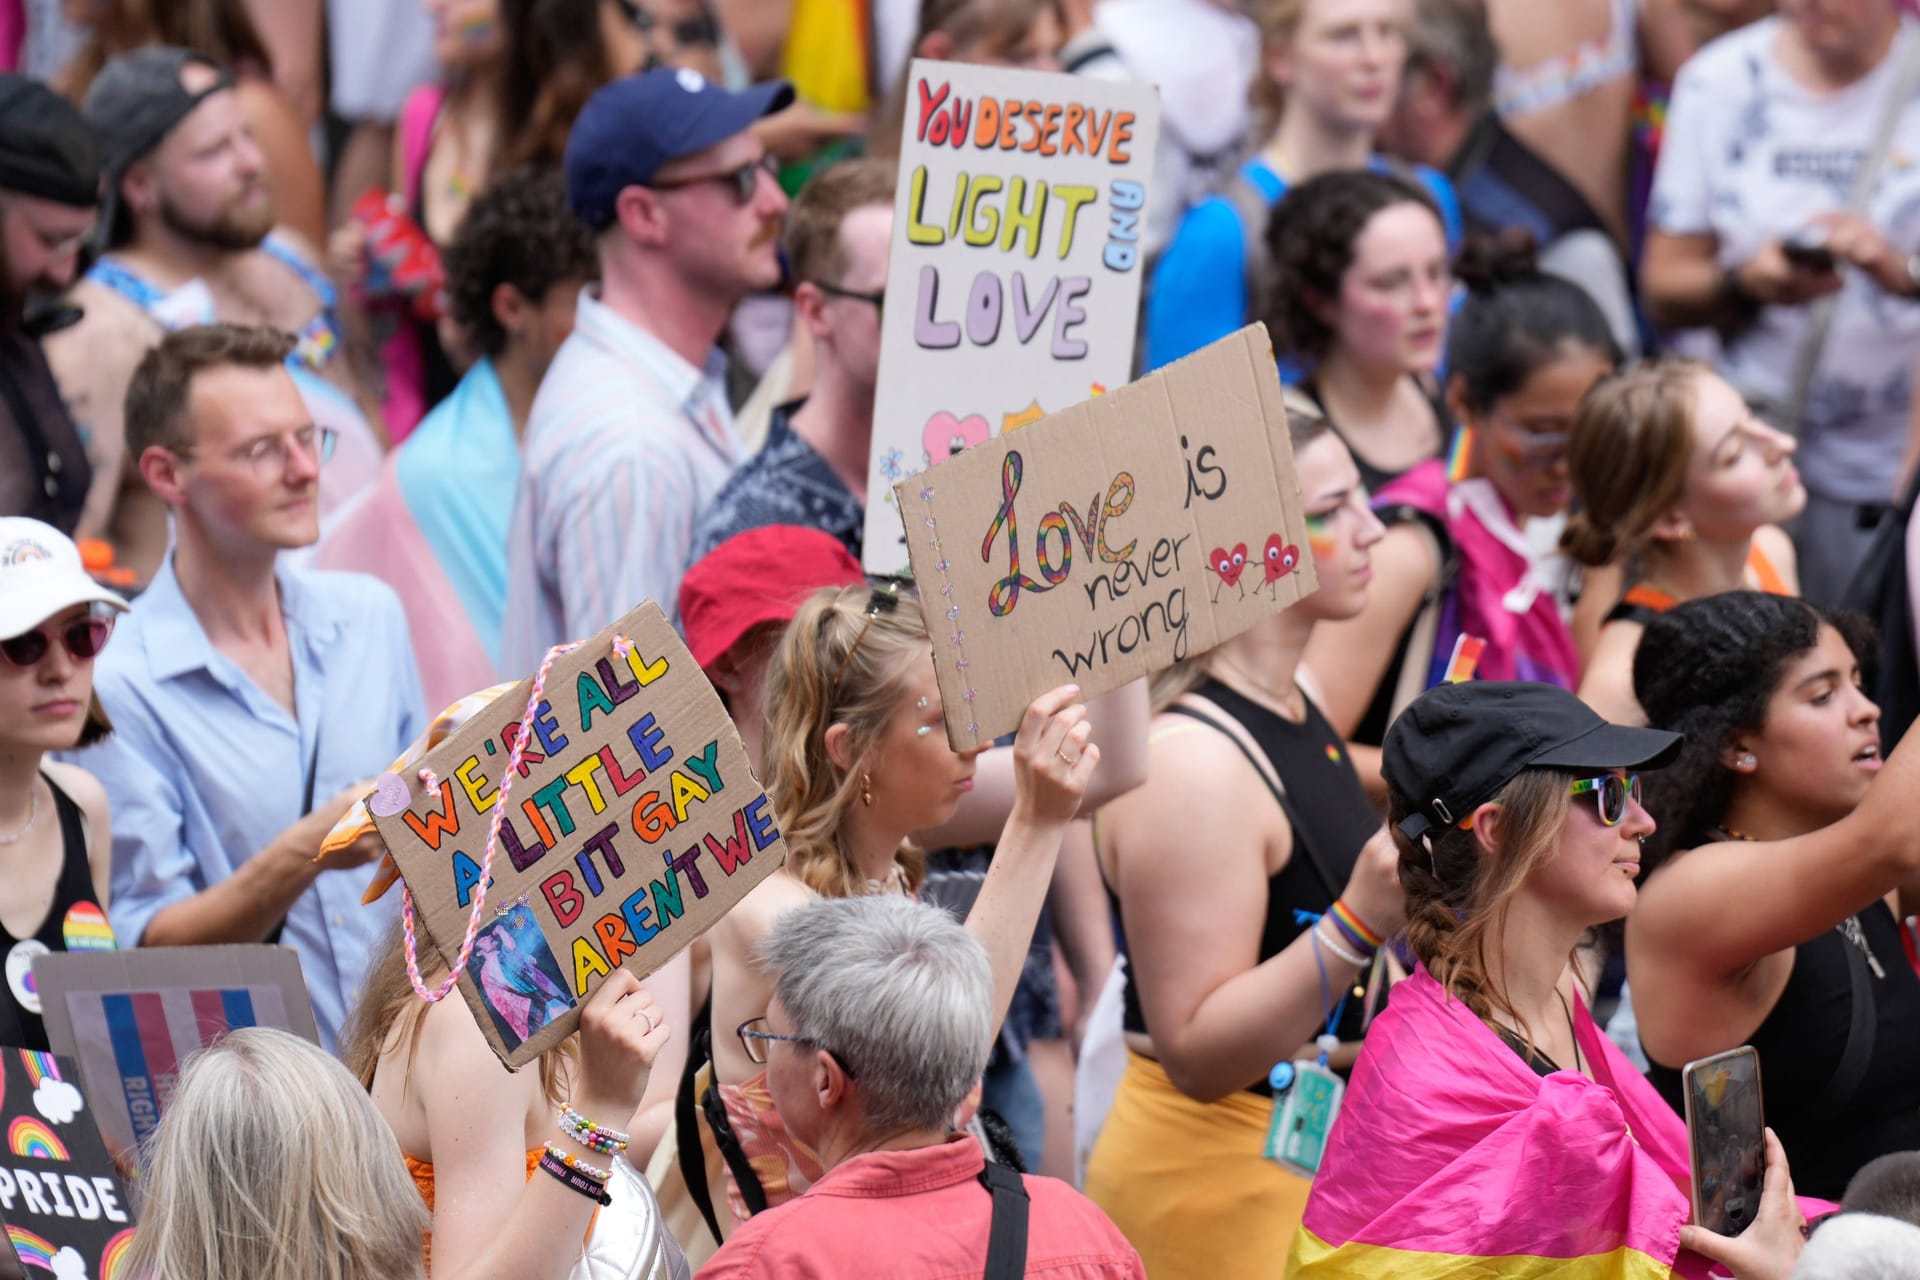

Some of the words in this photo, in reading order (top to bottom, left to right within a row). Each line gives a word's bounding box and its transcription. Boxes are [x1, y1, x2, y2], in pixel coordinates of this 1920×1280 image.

[917, 78, 973, 149] YOU
[973, 96, 1136, 164] DESERVE
[907, 164, 1098, 261] LIGHT
[1102, 178, 1146, 273] AND
[914, 264, 1092, 361] LOVE
[981, 450, 1138, 617] Love
[1180, 434, 1228, 510] is
[1084, 533, 1190, 610] never
[1052, 585, 1189, 678] wrong
[401, 699, 569, 852] WE'RE
[576, 640, 670, 732] ALL
[451, 850, 494, 908] A
[497, 711, 674, 873] LITTLE
[539, 821, 625, 929] BIT
[631, 739, 725, 845] GAY
[702, 793, 780, 877] WE
[0, 1165, 128, 1223] PRIDE
